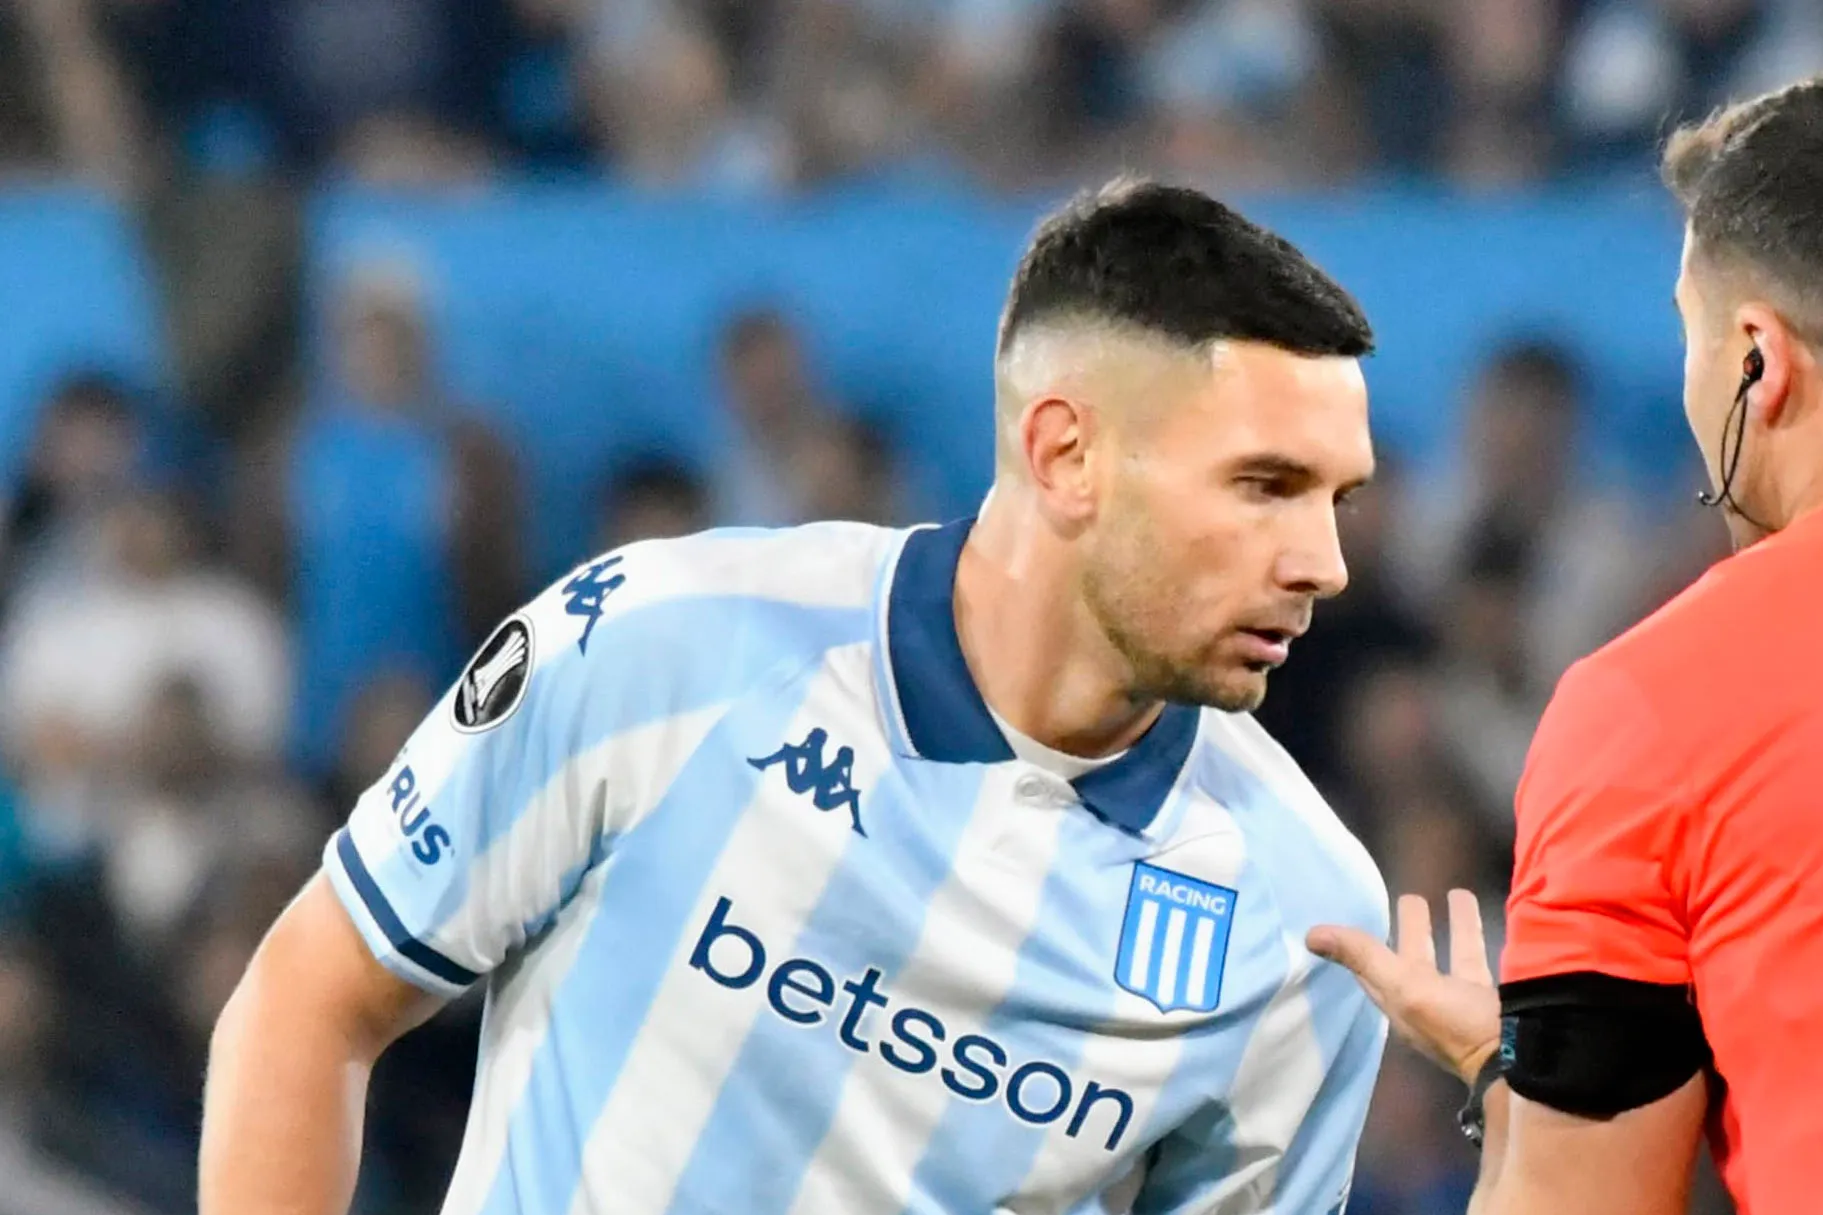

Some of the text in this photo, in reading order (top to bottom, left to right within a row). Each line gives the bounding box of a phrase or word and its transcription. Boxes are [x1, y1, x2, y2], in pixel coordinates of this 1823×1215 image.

[386, 764, 451, 866] RUS
[1139, 874, 1227, 916] RACING
[688, 895, 1135, 1152] betsson
